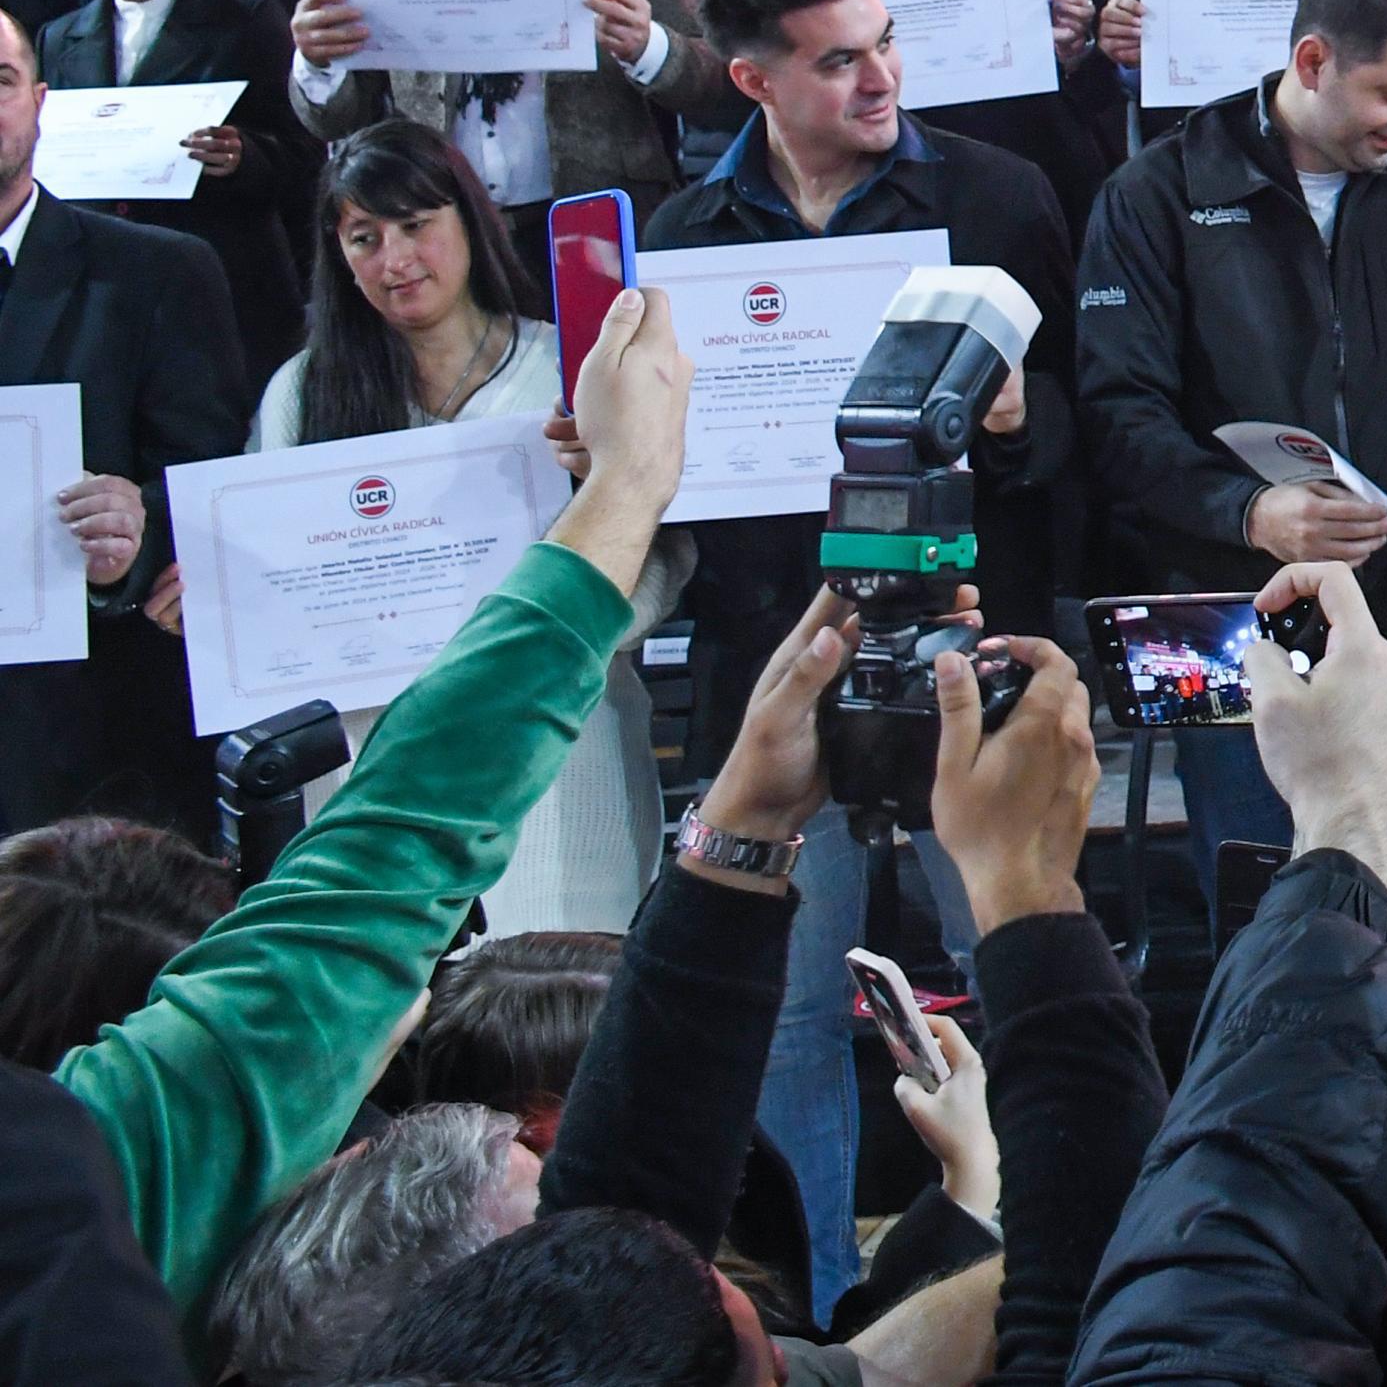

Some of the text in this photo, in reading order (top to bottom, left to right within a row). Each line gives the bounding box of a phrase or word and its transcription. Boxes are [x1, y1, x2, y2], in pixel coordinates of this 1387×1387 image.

[750, 298, 780, 311] UCR
[703, 329, 831, 346] UNIÓN CÍVICA RADICAL
[356, 490, 388, 505] UCR
[307, 516, 446, 545] UNIÓN CÍVICA RADICAL
